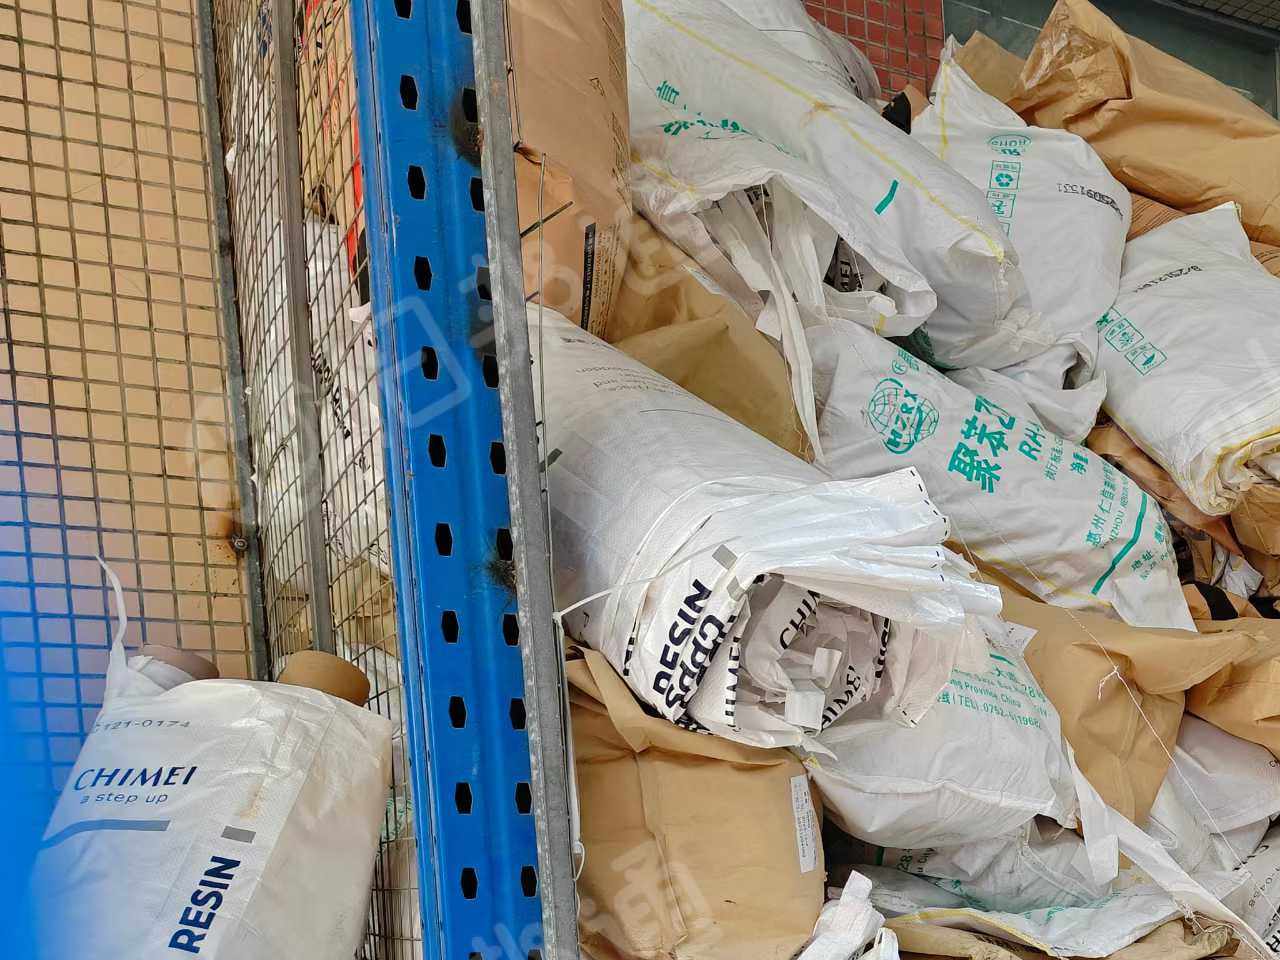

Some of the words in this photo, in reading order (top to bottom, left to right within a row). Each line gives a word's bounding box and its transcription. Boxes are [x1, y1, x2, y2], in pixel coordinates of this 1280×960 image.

[74, 766, 198, 791] CHIMEI
[95, 791, 138, 804] step
[145, 793, 169, 805] up
[168, 855, 242, 955] RESIN
